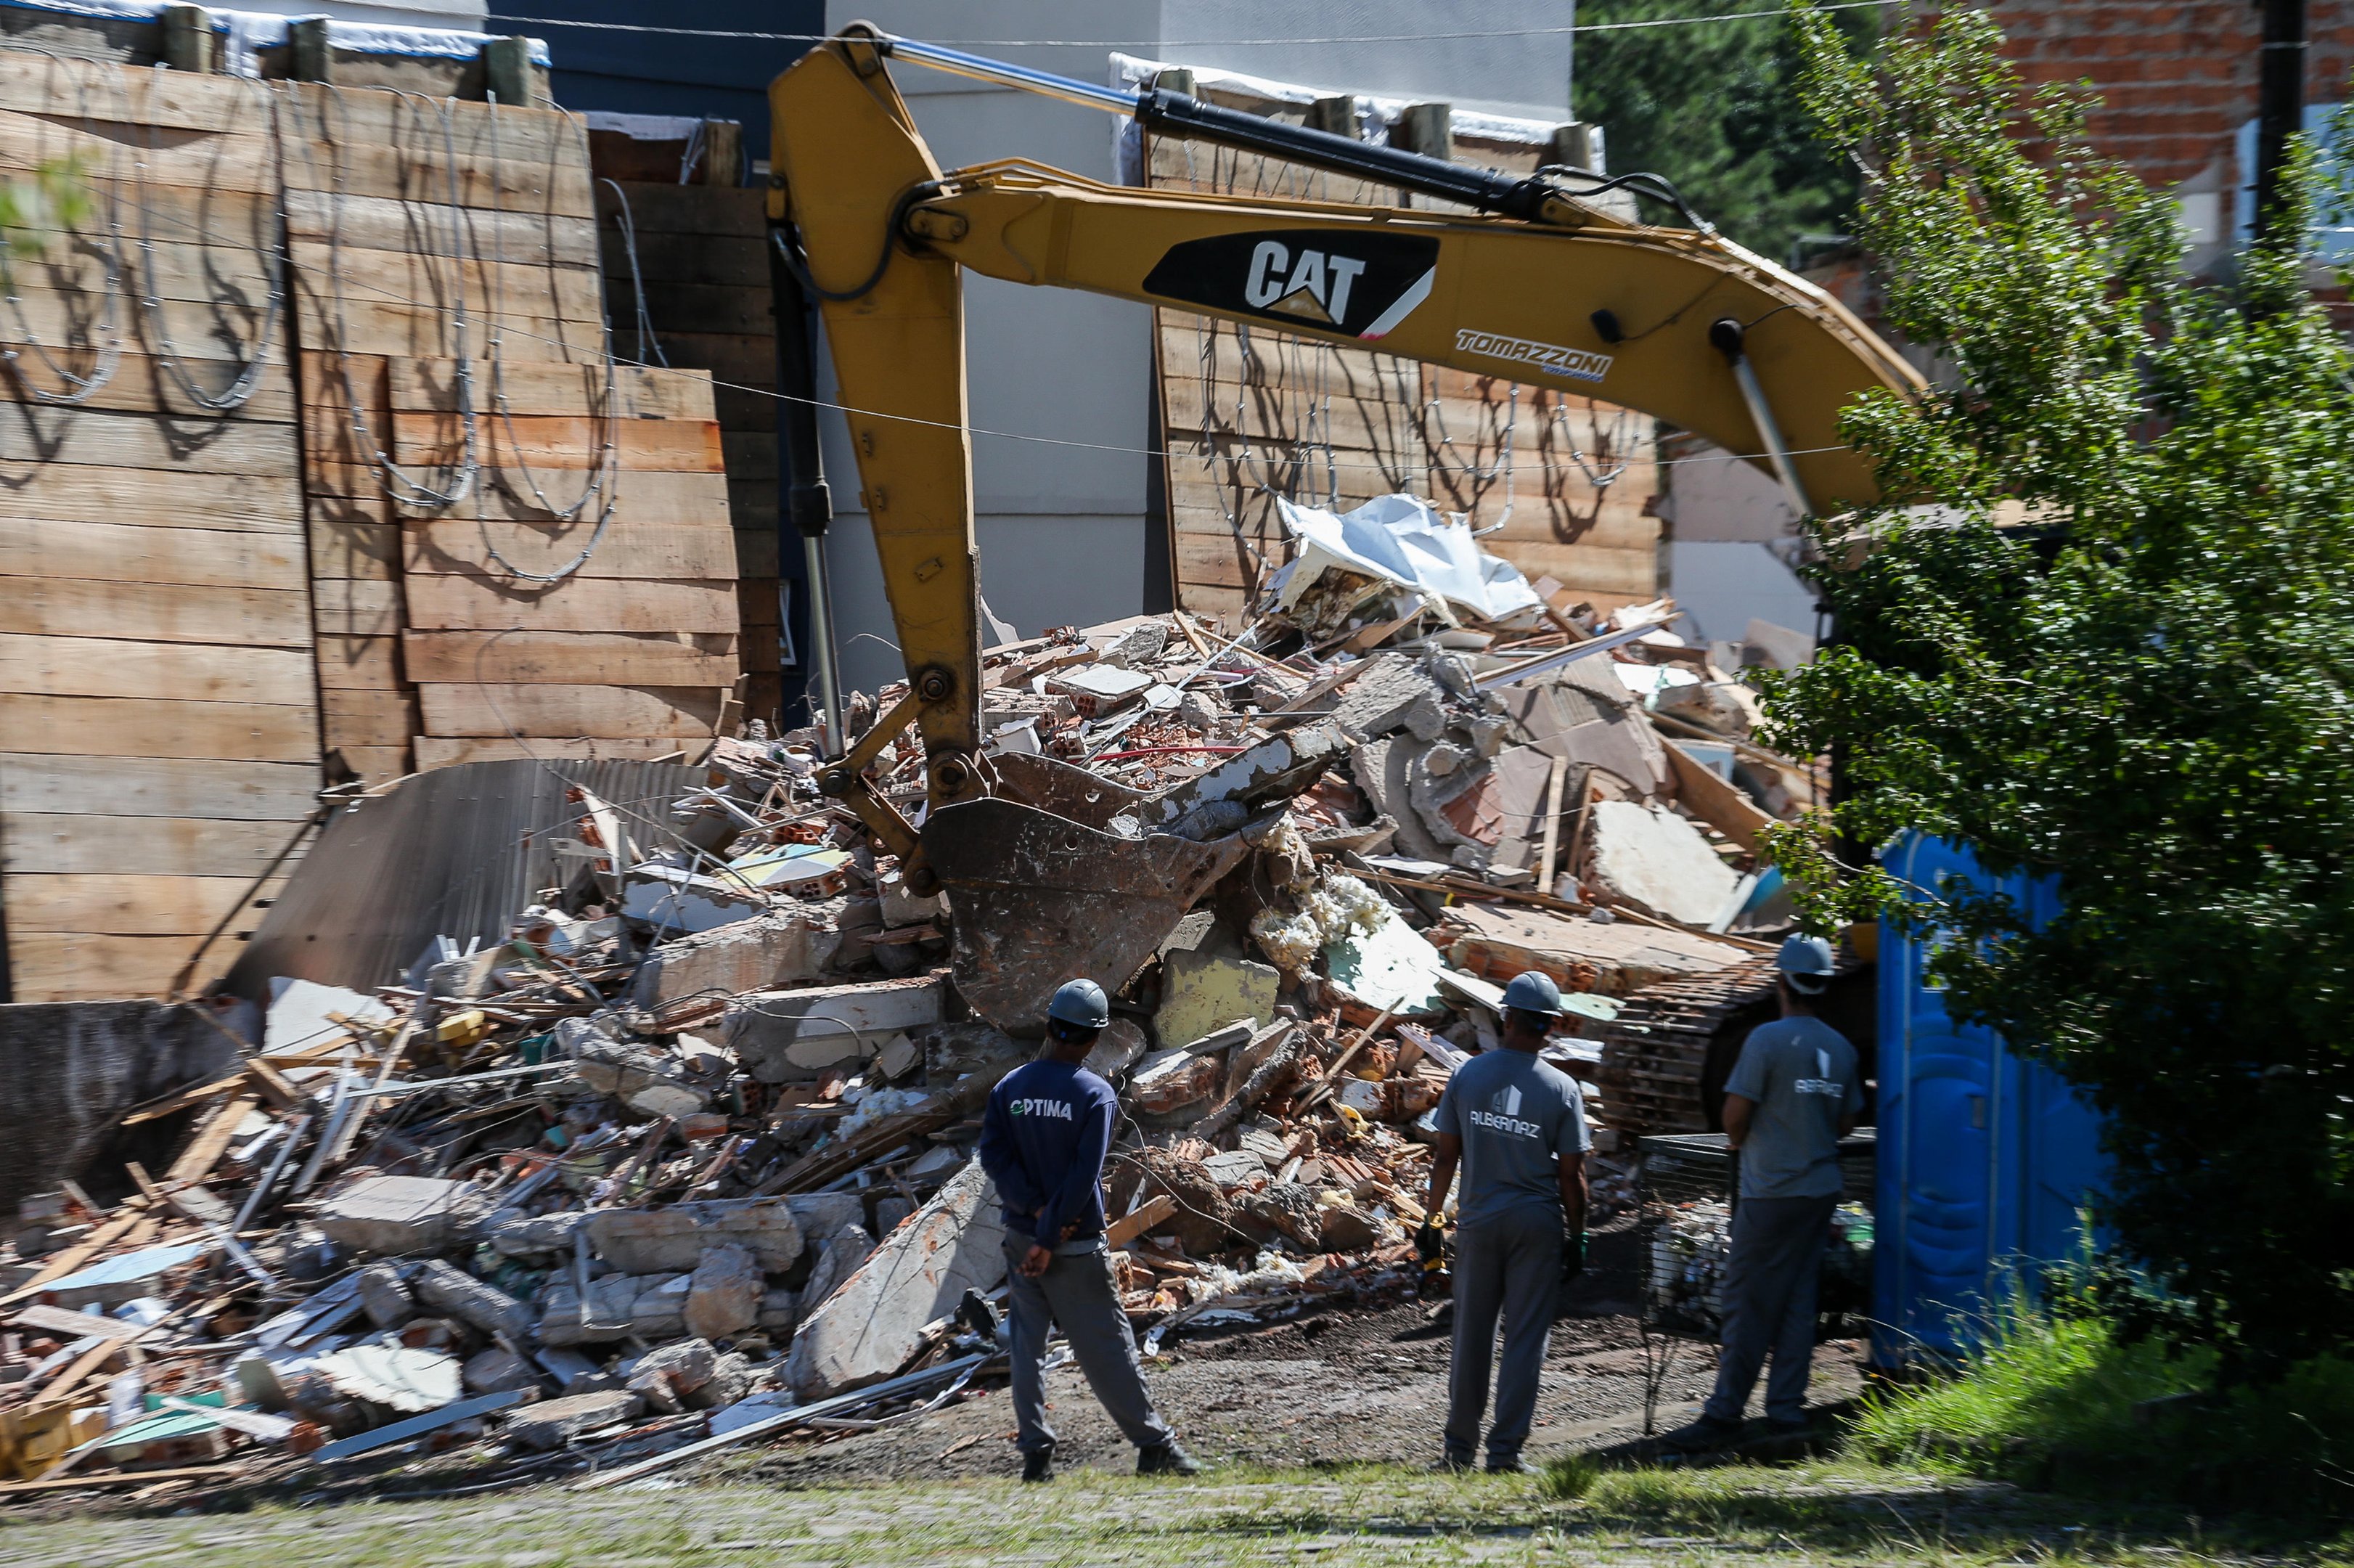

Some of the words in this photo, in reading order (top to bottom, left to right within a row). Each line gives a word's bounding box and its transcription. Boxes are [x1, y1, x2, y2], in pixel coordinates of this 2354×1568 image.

[1245, 240, 1367, 325] CAT
[1455, 328, 1614, 377] TOMAZZONI
[1010, 1098, 1072, 1121] OPTIMA
[1469, 1111, 1541, 1138] ALBERNAZ
